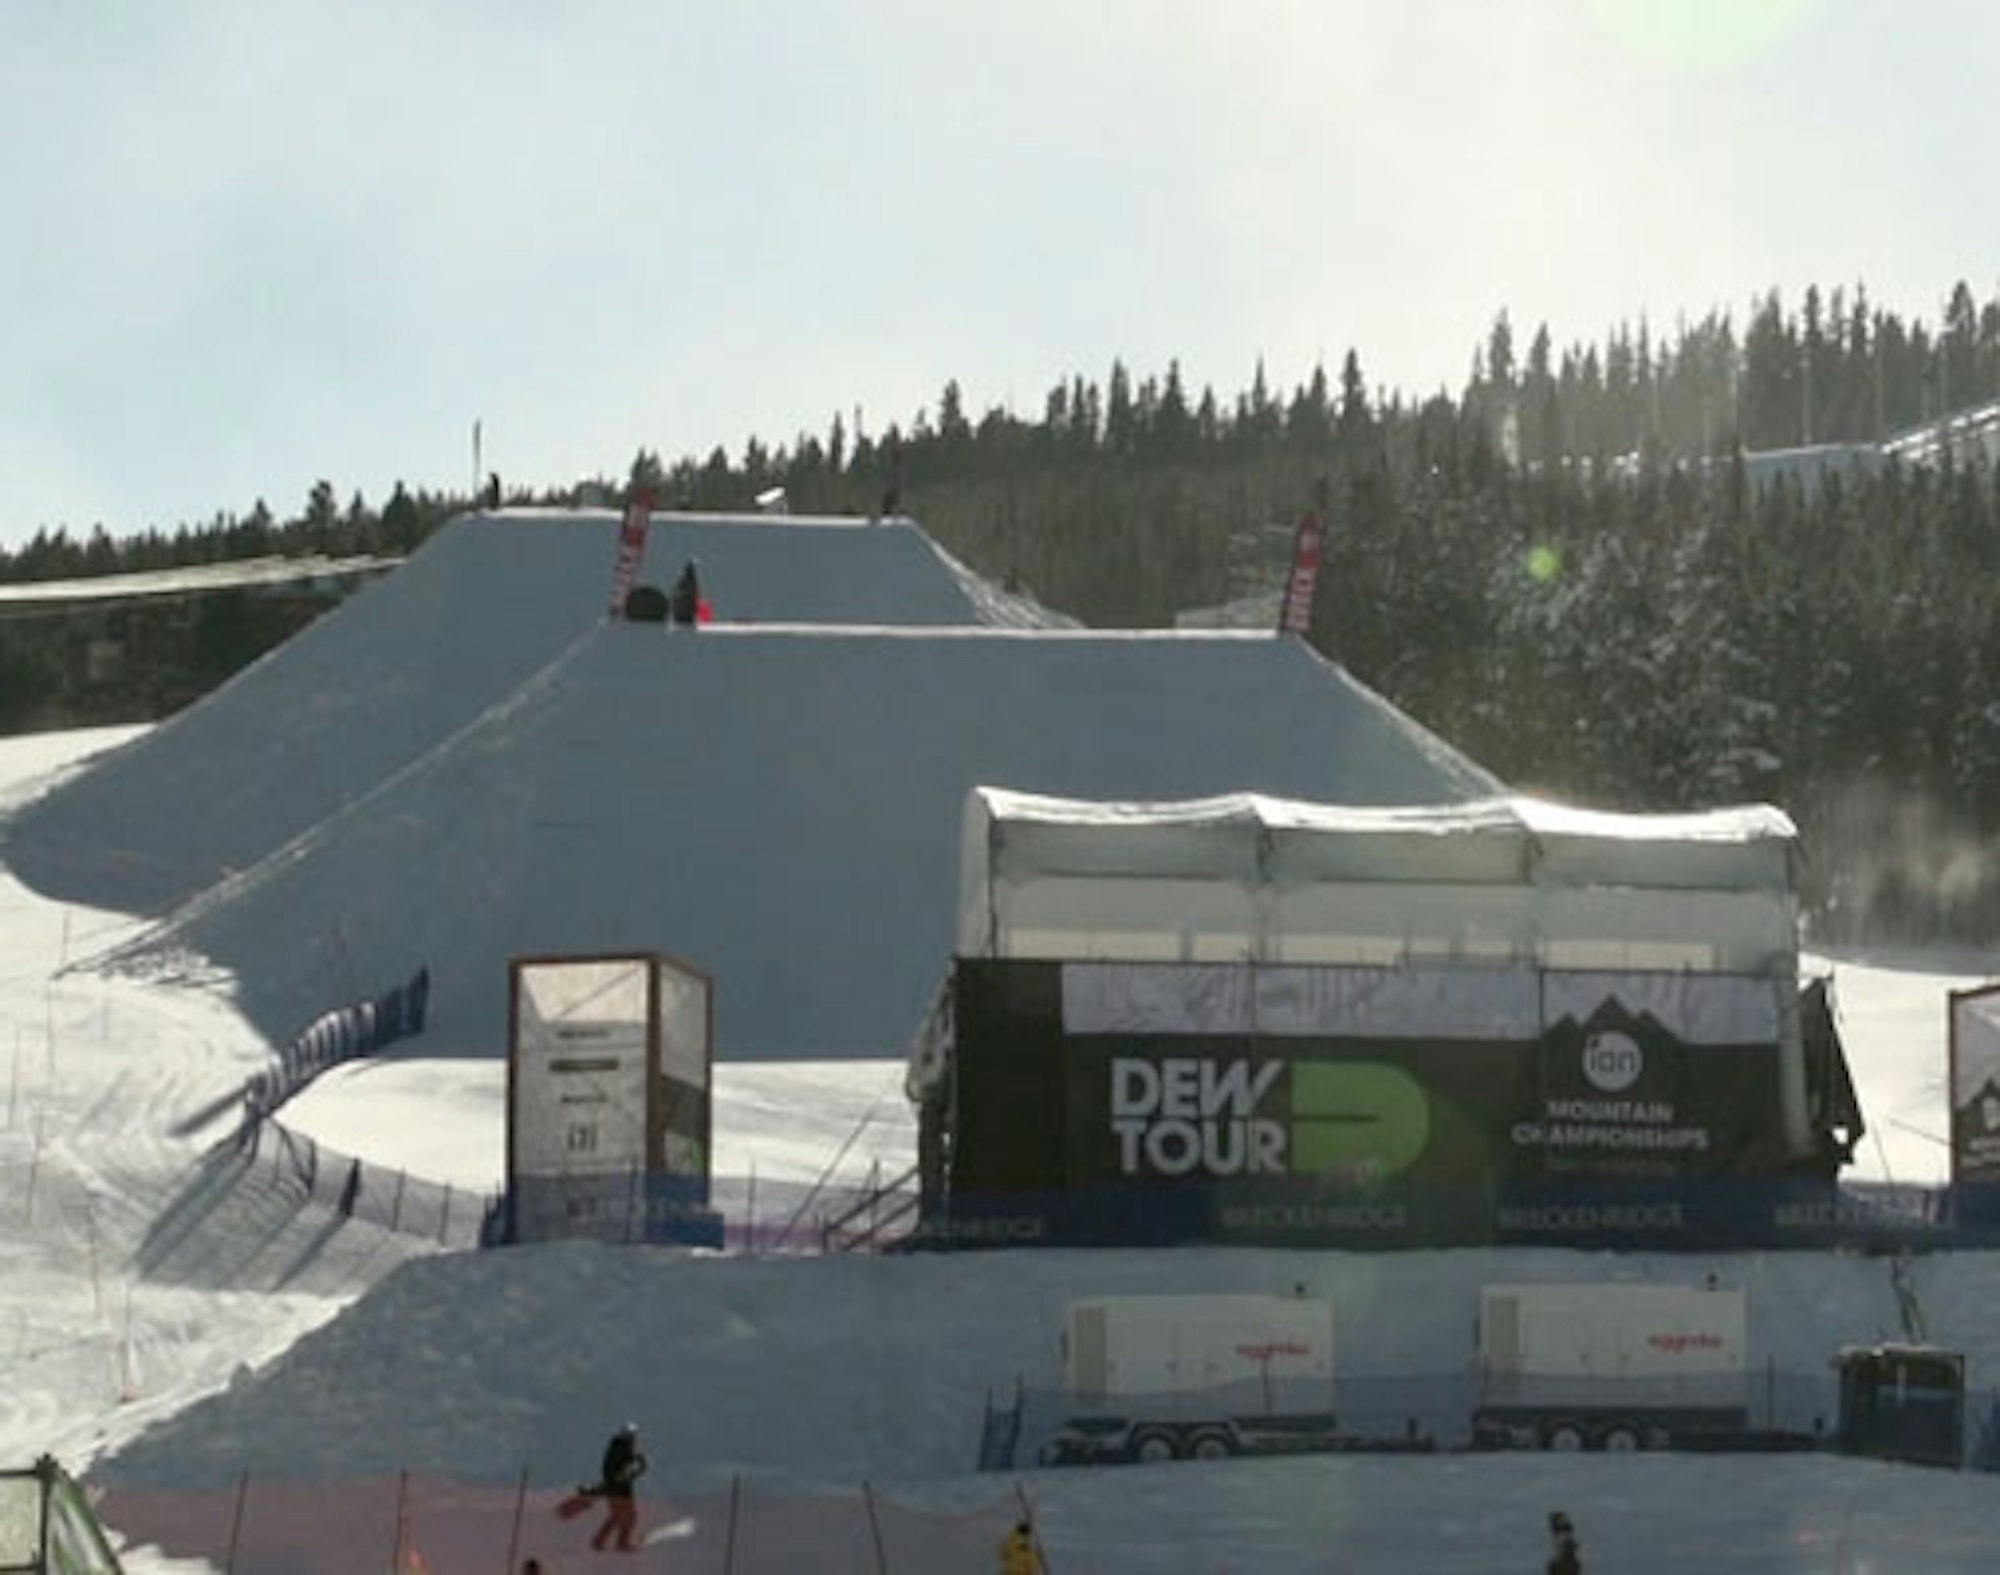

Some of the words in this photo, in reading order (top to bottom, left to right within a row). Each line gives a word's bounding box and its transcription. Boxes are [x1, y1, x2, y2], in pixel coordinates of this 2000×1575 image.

[1110, 1057, 1284, 1117] DEW
[1547, 1100, 1674, 1124] MOUNTAIN
[1111, 1118, 1286, 1176] TOUR
[1510, 1120, 1709, 1151] CHAMPIONSHIPS
